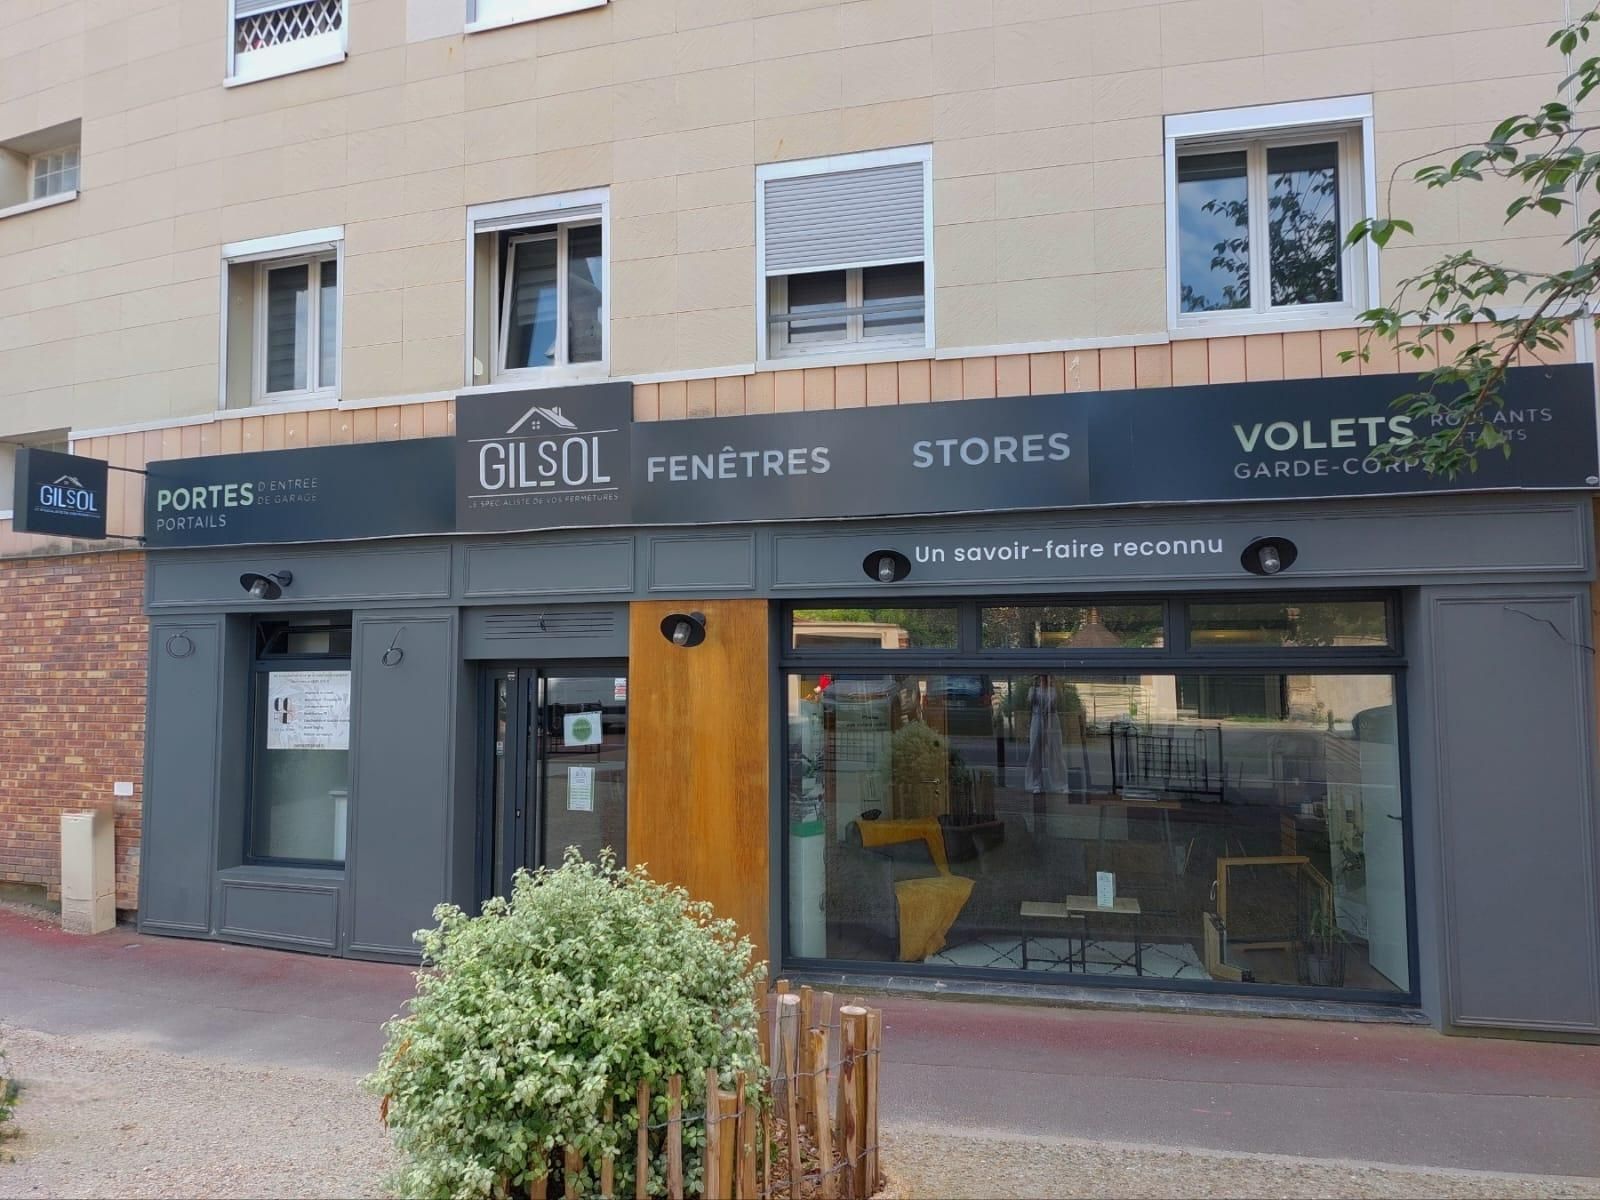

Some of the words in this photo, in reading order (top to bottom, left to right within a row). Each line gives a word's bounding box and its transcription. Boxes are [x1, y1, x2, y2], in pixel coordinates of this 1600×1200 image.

[1233, 415, 1414, 453] VOLETS
[479, 436, 611, 490] GILSOL
[647, 445, 832, 482] FENÊTRES
[912, 432, 1071, 469] STORES
[40, 485, 98, 512] GILSOL
[157, 482, 255, 512] PORTES
[257, 496, 271, 505] DE
[274, 493, 318, 504] GARAGE
[156, 514, 227, 532] PORTAILS
[915, 545, 945, 563] Un
[954, 539, 1104, 562] savoir-faire
[1114, 538, 1223, 557] reconnu
